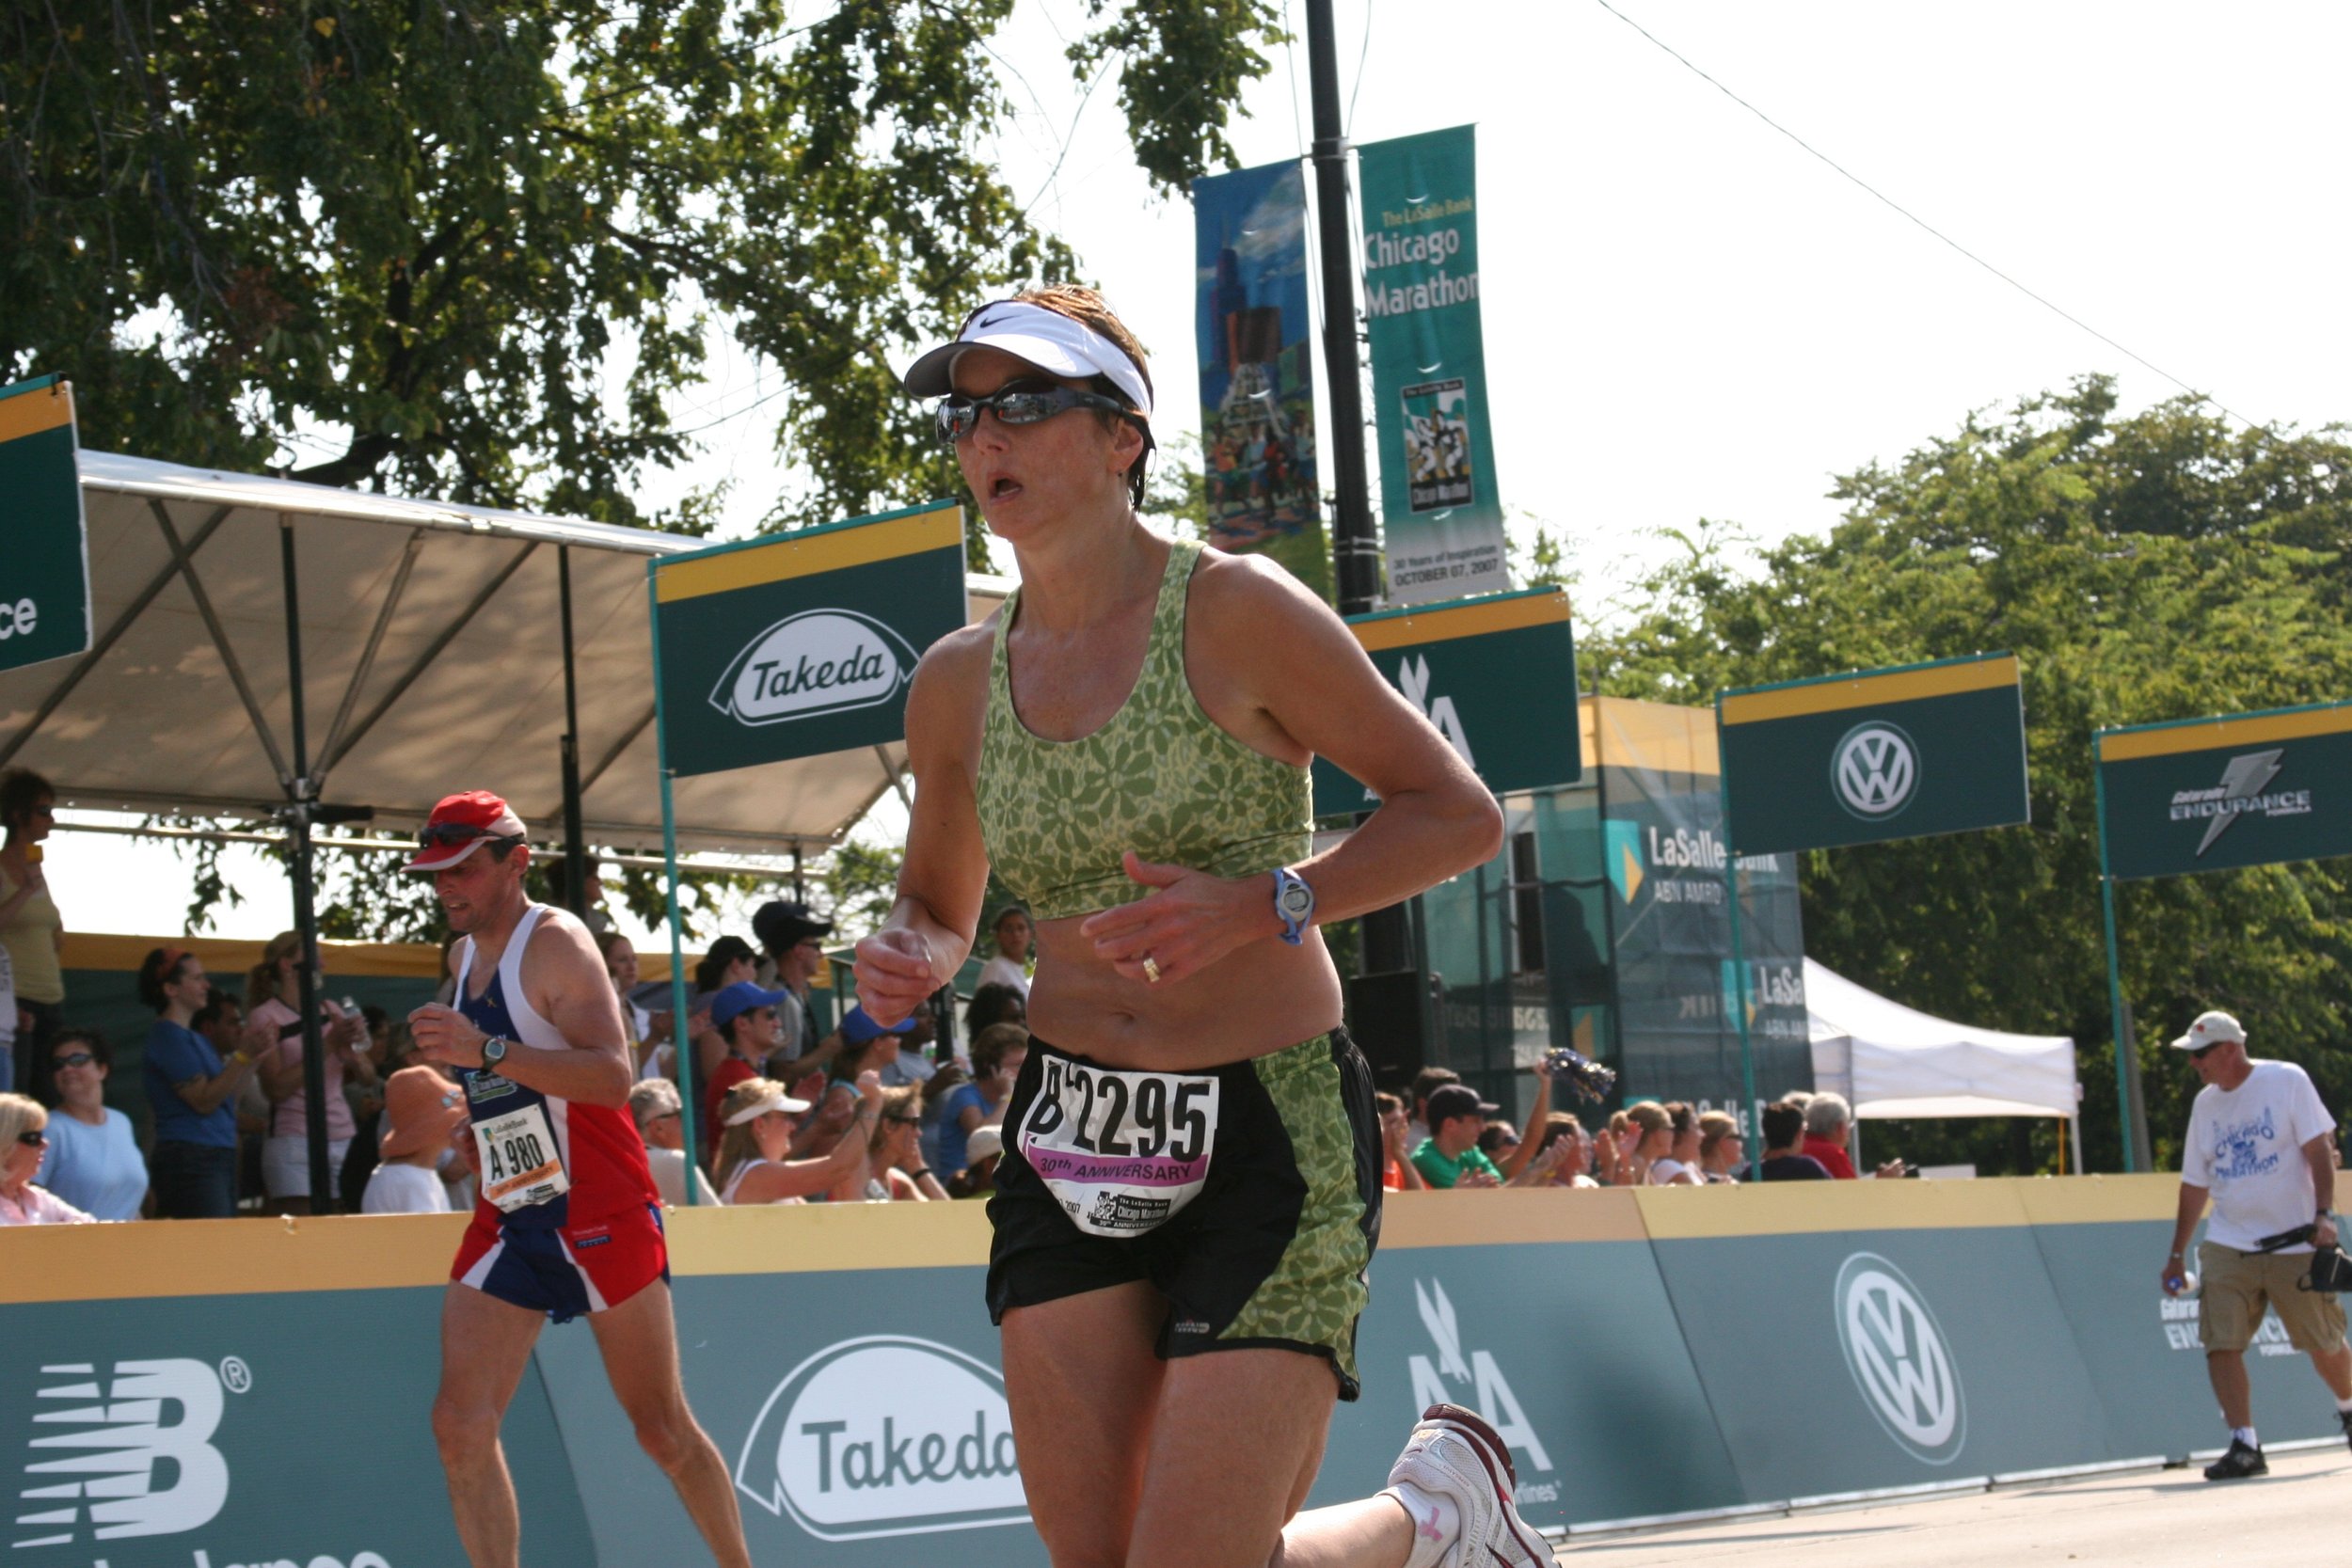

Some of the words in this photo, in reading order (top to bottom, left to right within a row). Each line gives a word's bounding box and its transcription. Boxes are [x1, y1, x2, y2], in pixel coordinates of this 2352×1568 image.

[1364, 228, 1460, 270] Chicago
[1364, 269, 1478, 318] Marathon
[1394, 566, 1448, 586] OCTOBER
[1470, 558, 1499, 575] 2007
[753, 644, 885, 702] Takeda
[2169, 790, 2311, 820] ENDURANCE
[1649, 826, 1727, 869] LaSalle
[1655, 880, 1682, 902] ABN
[1025, 1060, 1064, 1134] B
[1073, 1069, 1210, 1163] 2295
[489, 1145, 504, 1180] A
[505, 1133, 545, 1175] 980
[1040, 1157, 1072, 1173] 30th
[1074, 1164, 1192, 1180] ANNIVERSARY
[801, 1409, 1020, 1494] Takeda
